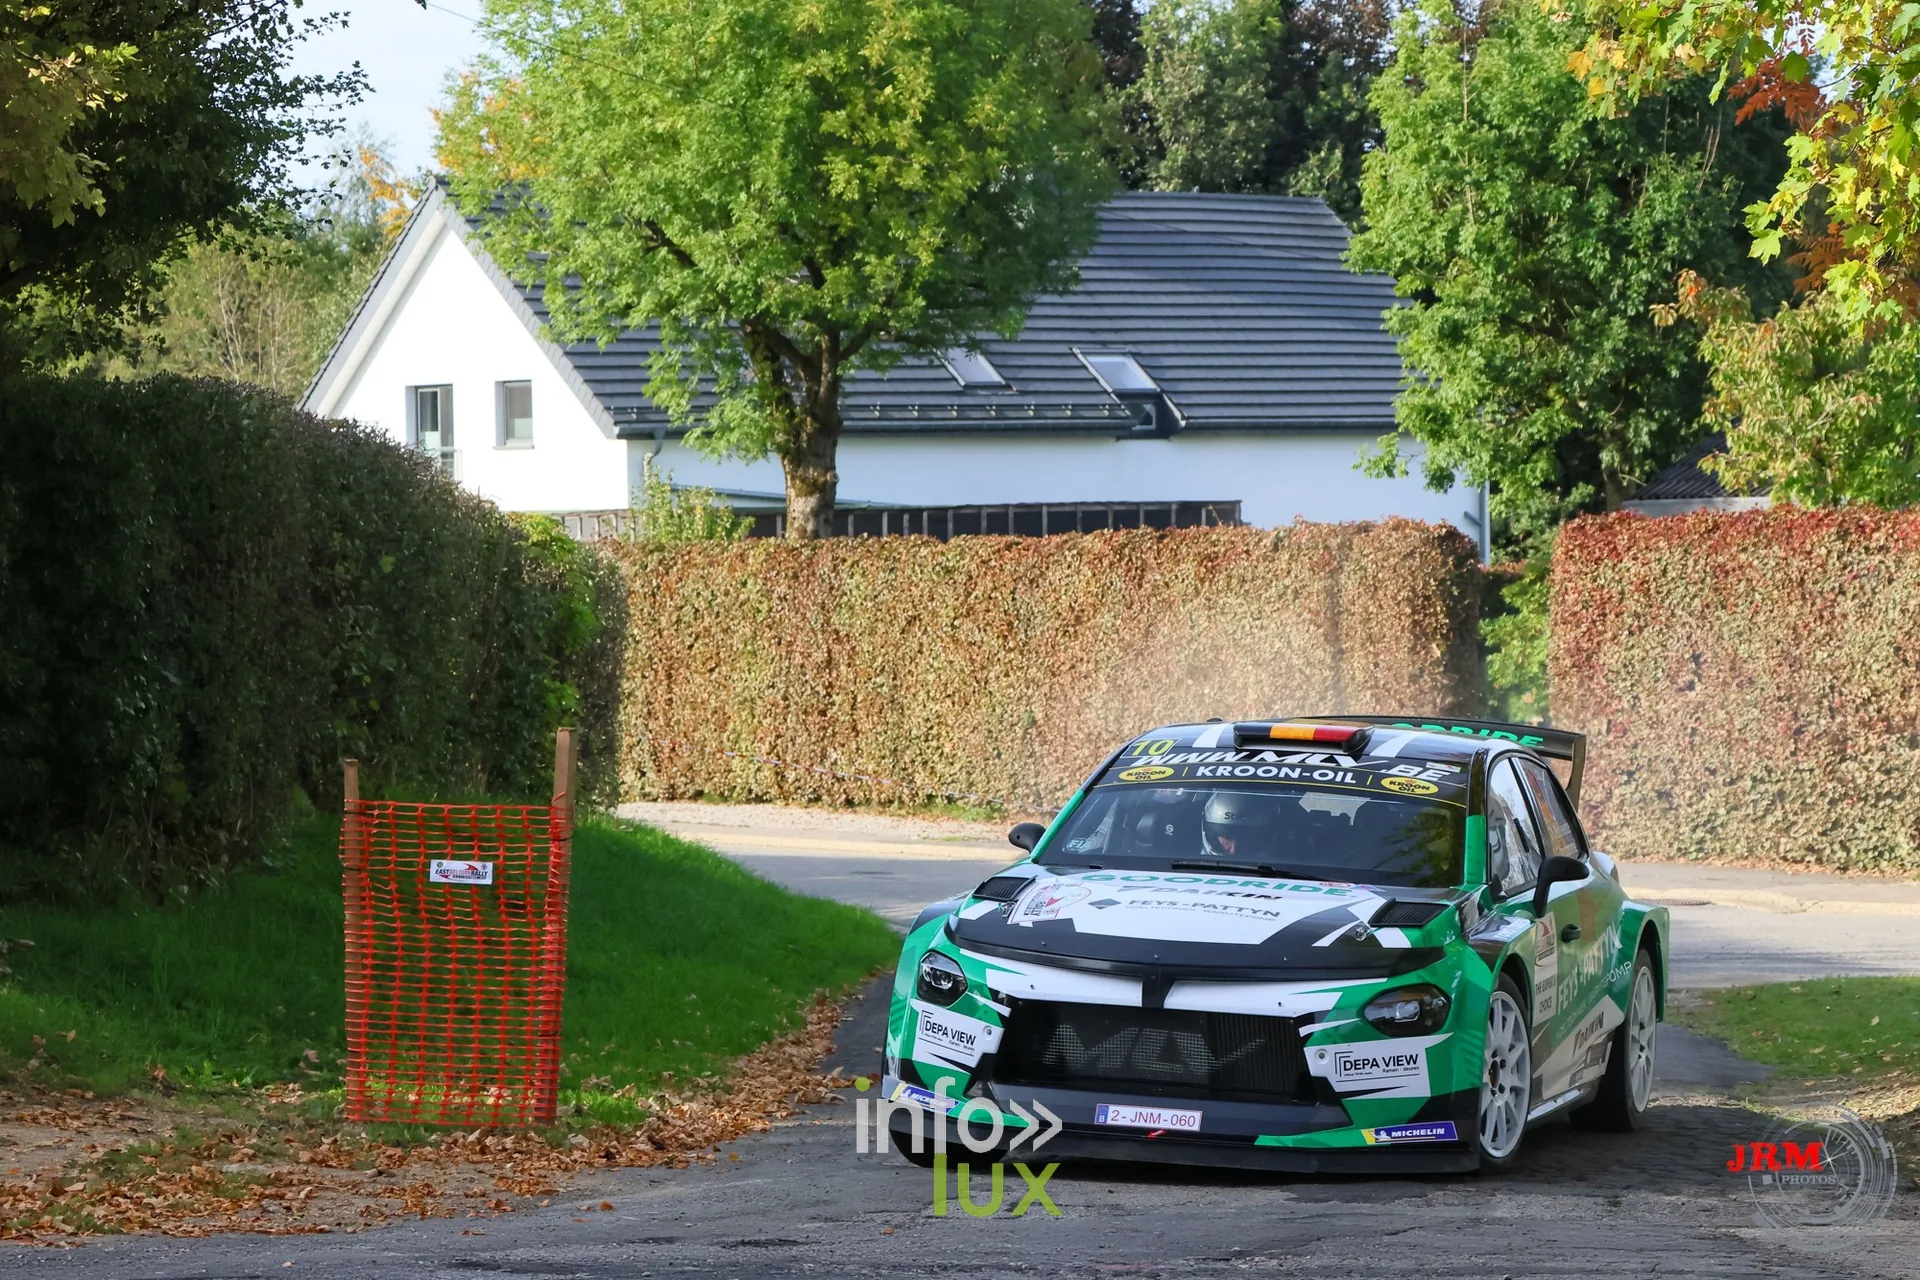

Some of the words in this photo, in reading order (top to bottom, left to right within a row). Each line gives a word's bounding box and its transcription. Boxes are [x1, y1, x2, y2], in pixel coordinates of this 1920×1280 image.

[1132, 739, 1175, 756] 10
[1195, 765, 1356, 784] KROON-OIL
[1388, 780, 1431, 791] KROON
[1081, 874, 1353, 897] GOODRIDE
[1150, 887, 1283, 900] DAIKIN
[925, 1020, 949, 1038] DEPA
[951, 1028, 977, 1046] VIEW
[1343, 1057, 1380, 1071] DEPA
[1382, 1053, 1419, 1067] VIEW
[1391, 1128, 1445, 1137] MICHELIN
